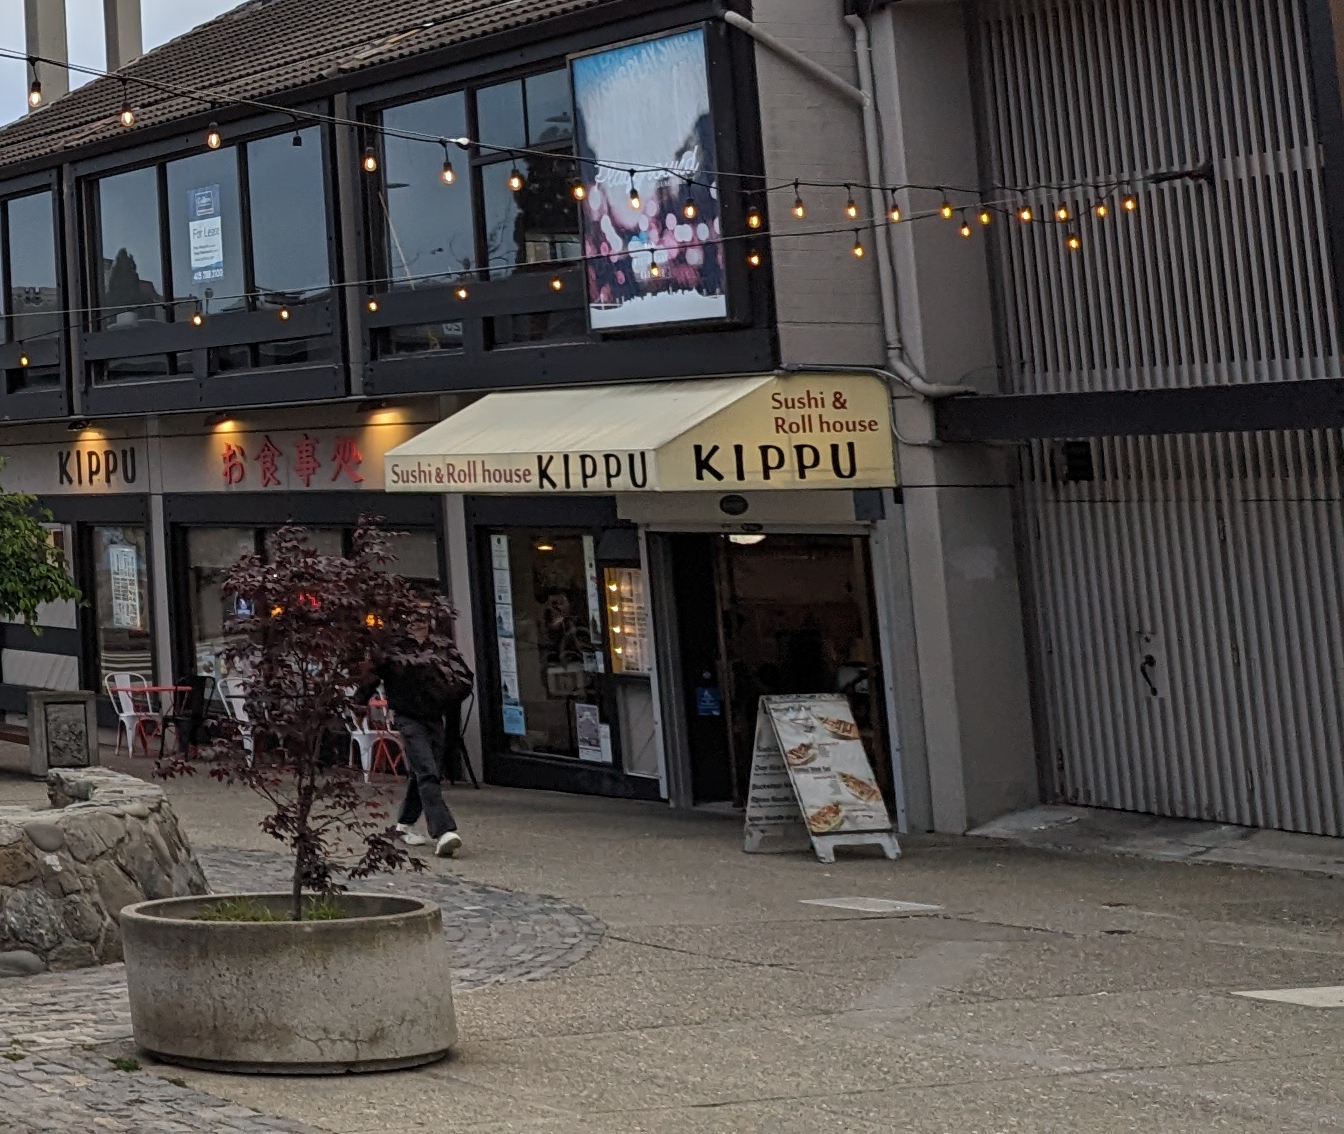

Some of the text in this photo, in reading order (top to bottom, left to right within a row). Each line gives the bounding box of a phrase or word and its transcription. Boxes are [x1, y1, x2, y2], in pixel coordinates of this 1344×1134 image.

[771, 390, 848, 410] Sushi &
[774, 414, 879, 434] Roll house
[57, 446, 137, 485] KIPPU
[221, 433, 364, 487] お食事処
[391, 451, 648, 489] Sushi & Roll house KIPPU
[693, 441, 857, 482] KIPPU
